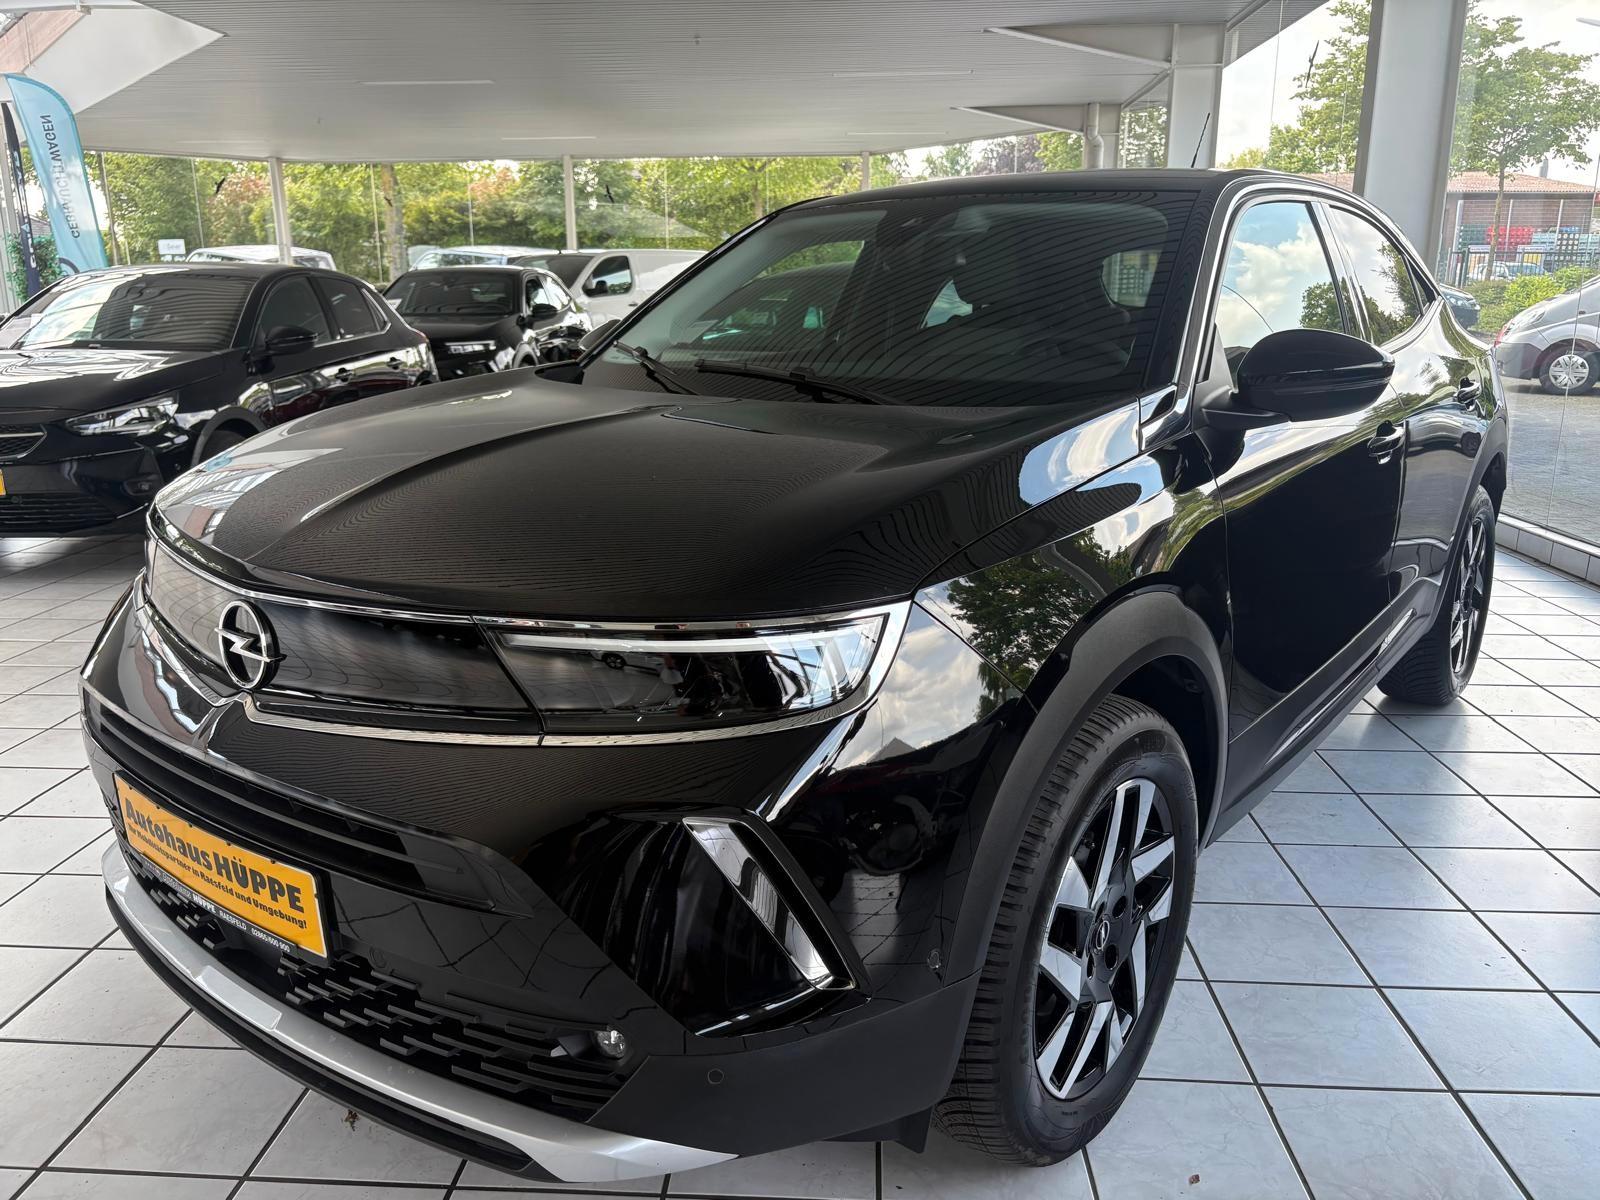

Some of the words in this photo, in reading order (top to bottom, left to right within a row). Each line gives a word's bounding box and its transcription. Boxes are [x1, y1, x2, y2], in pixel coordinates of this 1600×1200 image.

[125, 797, 213, 871] Autohaus
[213, 851, 305, 914] HÜPPE
[200, 871, 234, 898] Raesfeld
[235, 888, 252, 905] und
[253, 900, 308, 930] Umgebung!
